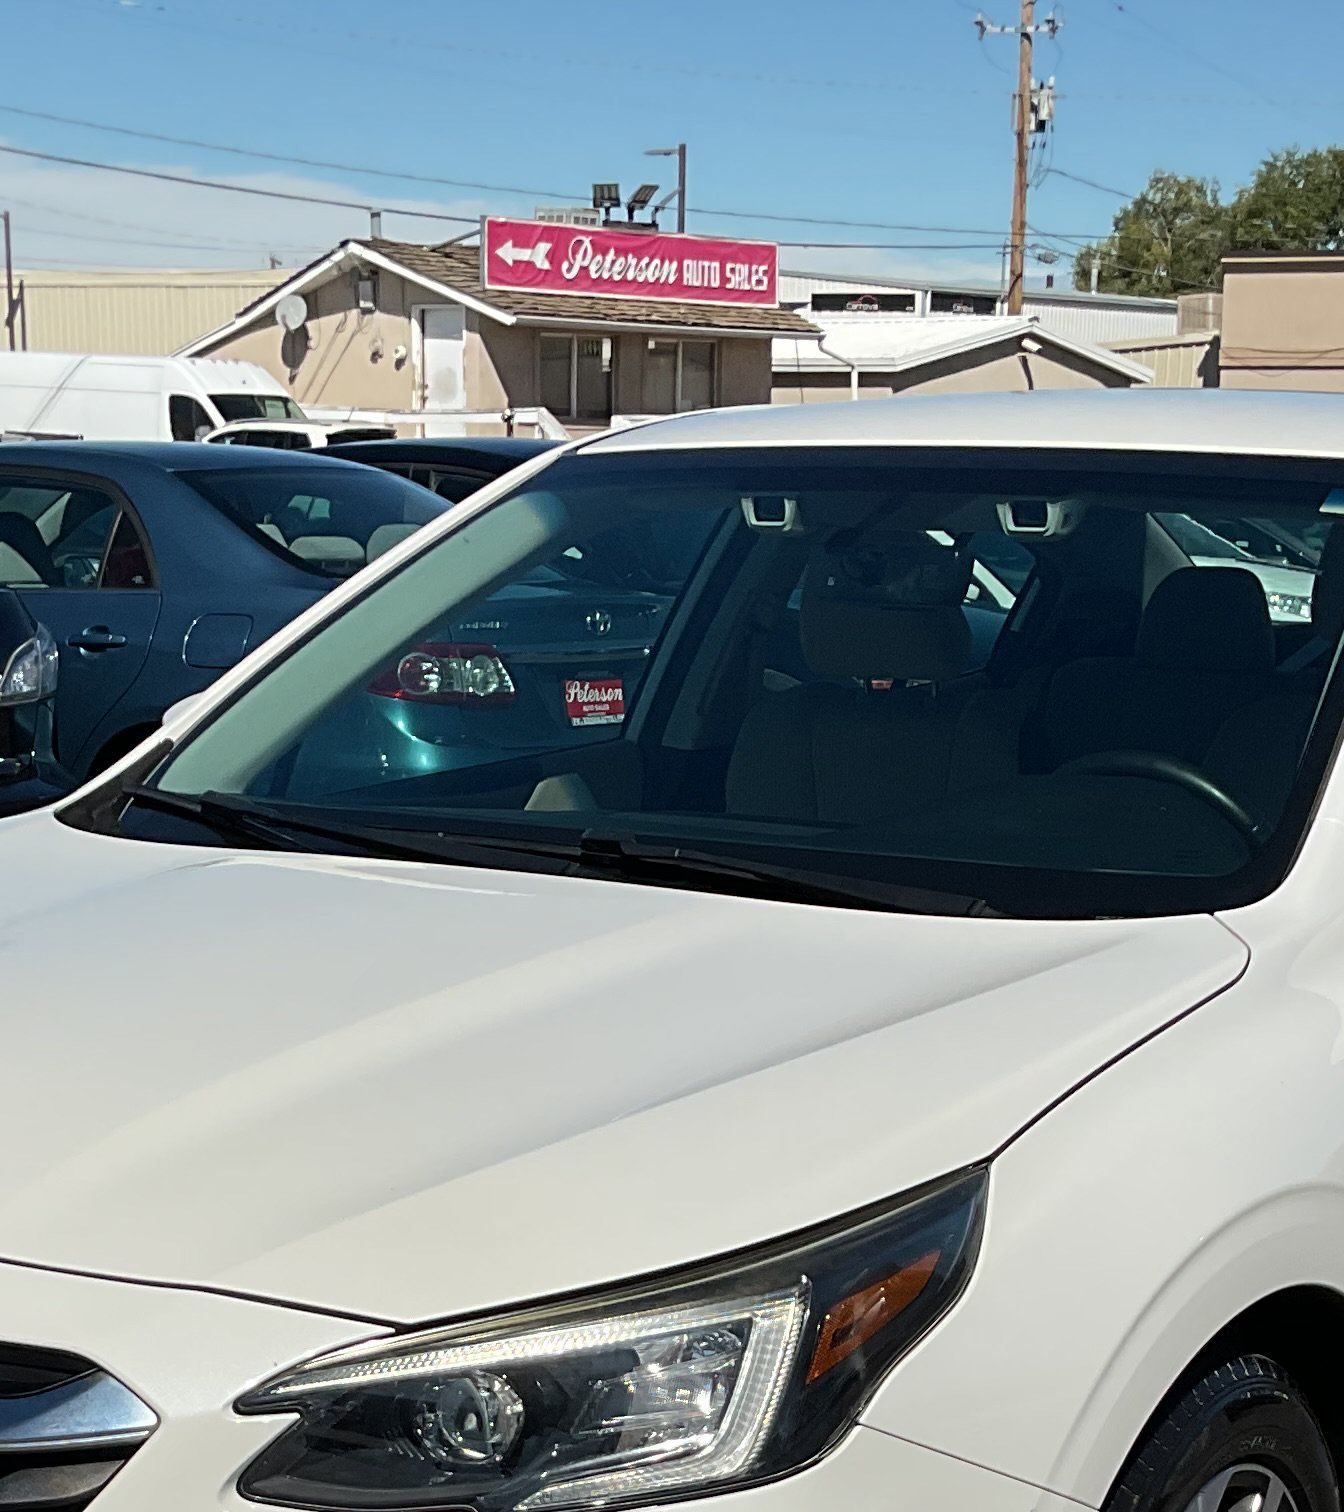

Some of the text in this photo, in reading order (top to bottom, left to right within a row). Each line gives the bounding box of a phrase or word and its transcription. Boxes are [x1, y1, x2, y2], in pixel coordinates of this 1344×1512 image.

[561, 235, 769, 292] Peterson AUTO SALES
[565, 680, 624, 703] Peterson
